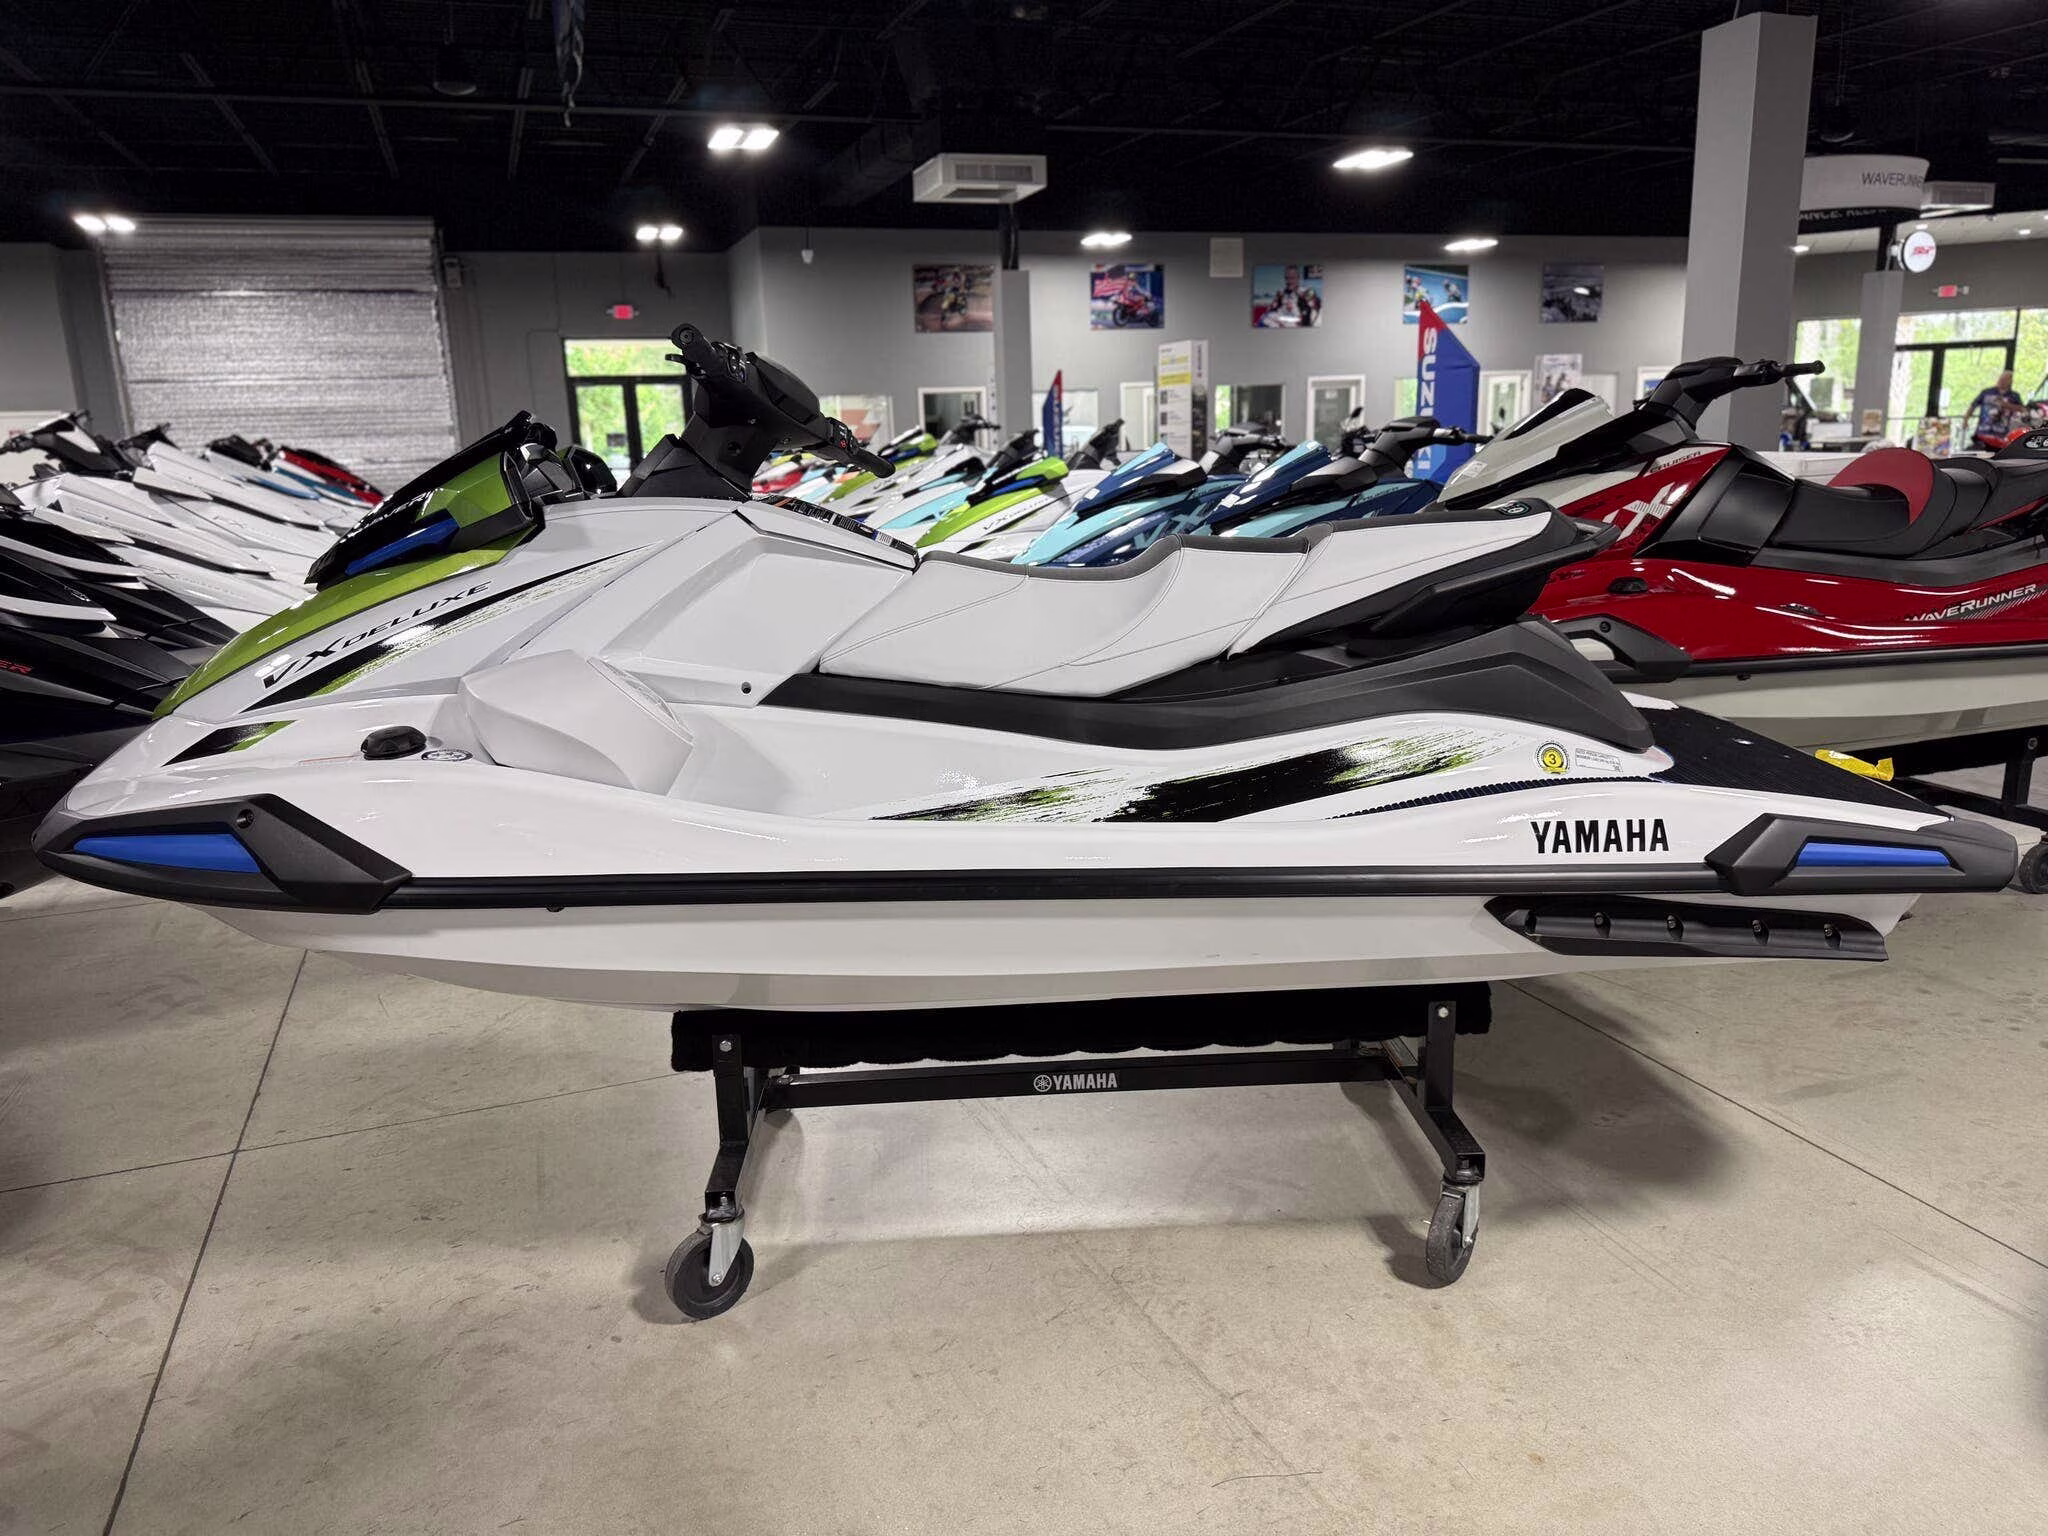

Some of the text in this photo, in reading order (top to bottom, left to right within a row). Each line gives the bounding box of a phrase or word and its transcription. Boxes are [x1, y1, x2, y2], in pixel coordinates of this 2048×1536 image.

[1649, 451, 1701, 473] CRUISER
[262, 580, 492, 689] VX DELUXE
[1547, 753, 1557, 765] 3
[1530, 819, 1669, 854] YAMAHA
[1053, 1073, 1118, 1090] YAMAHA
